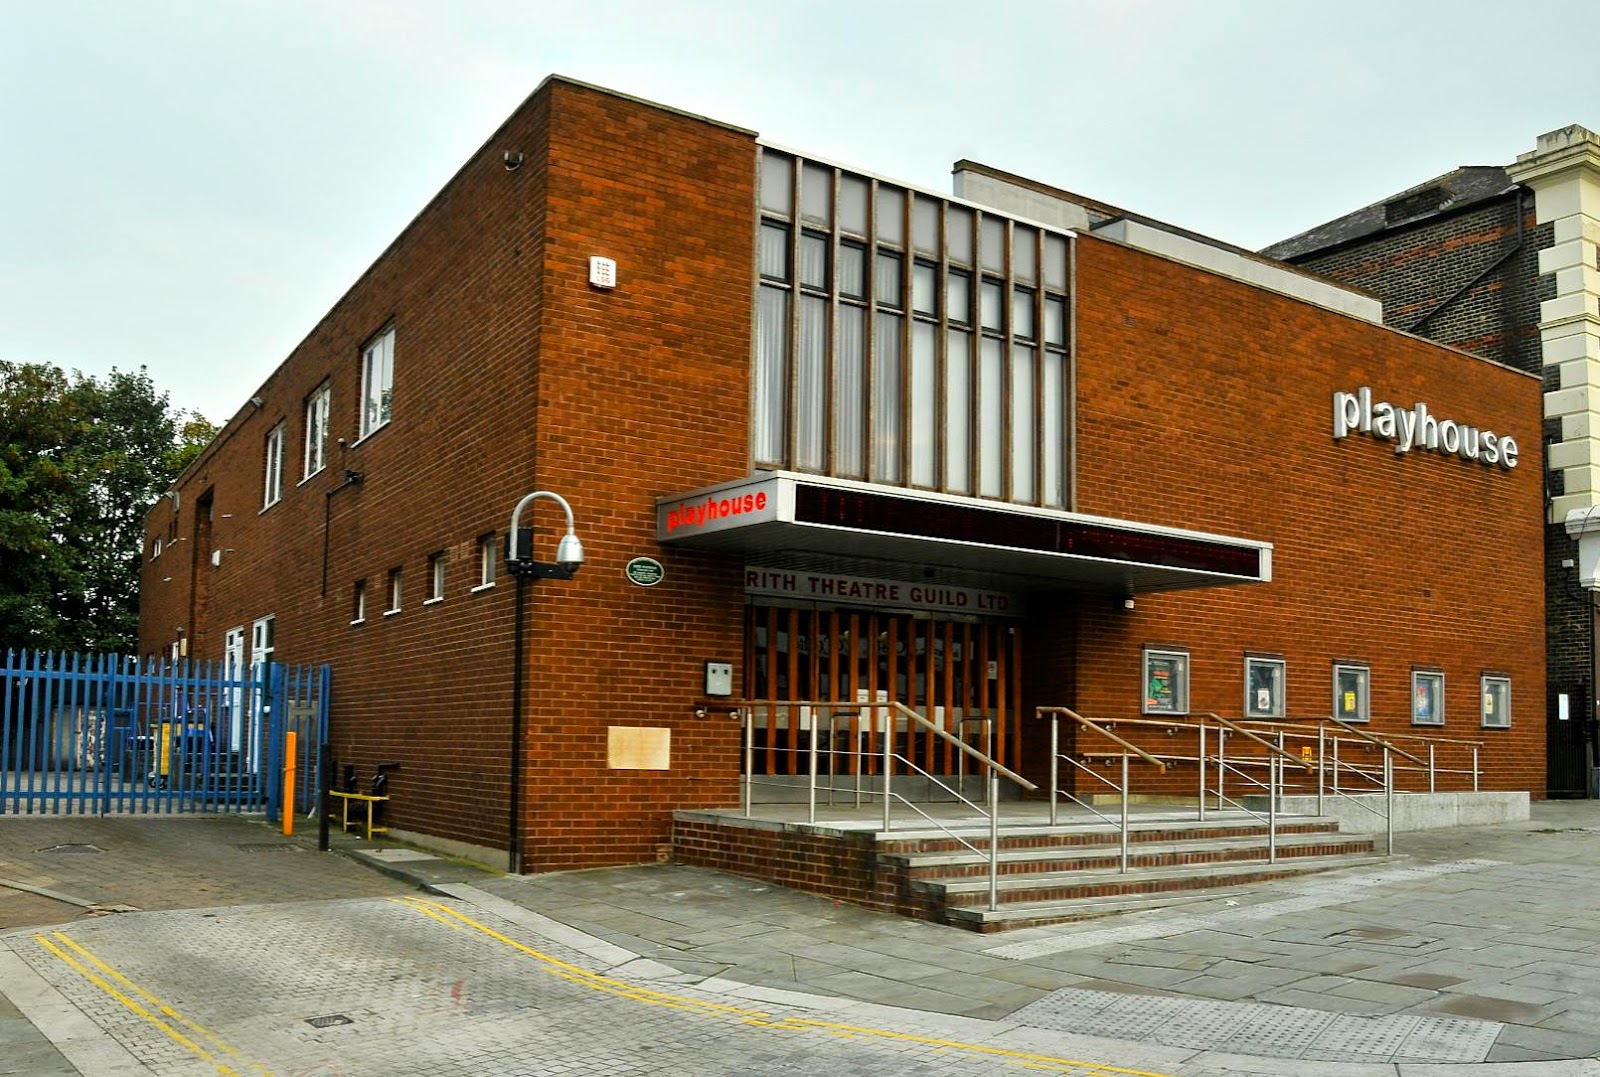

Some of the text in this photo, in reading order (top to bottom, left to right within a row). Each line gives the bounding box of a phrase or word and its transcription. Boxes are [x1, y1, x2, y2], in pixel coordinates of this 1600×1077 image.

[1333, 386, 1518, 469] playhouse
[667, 491, 767, 534] playhouse
[747, 571, 1009, 610] RITH THEATRE GUILD LTD
